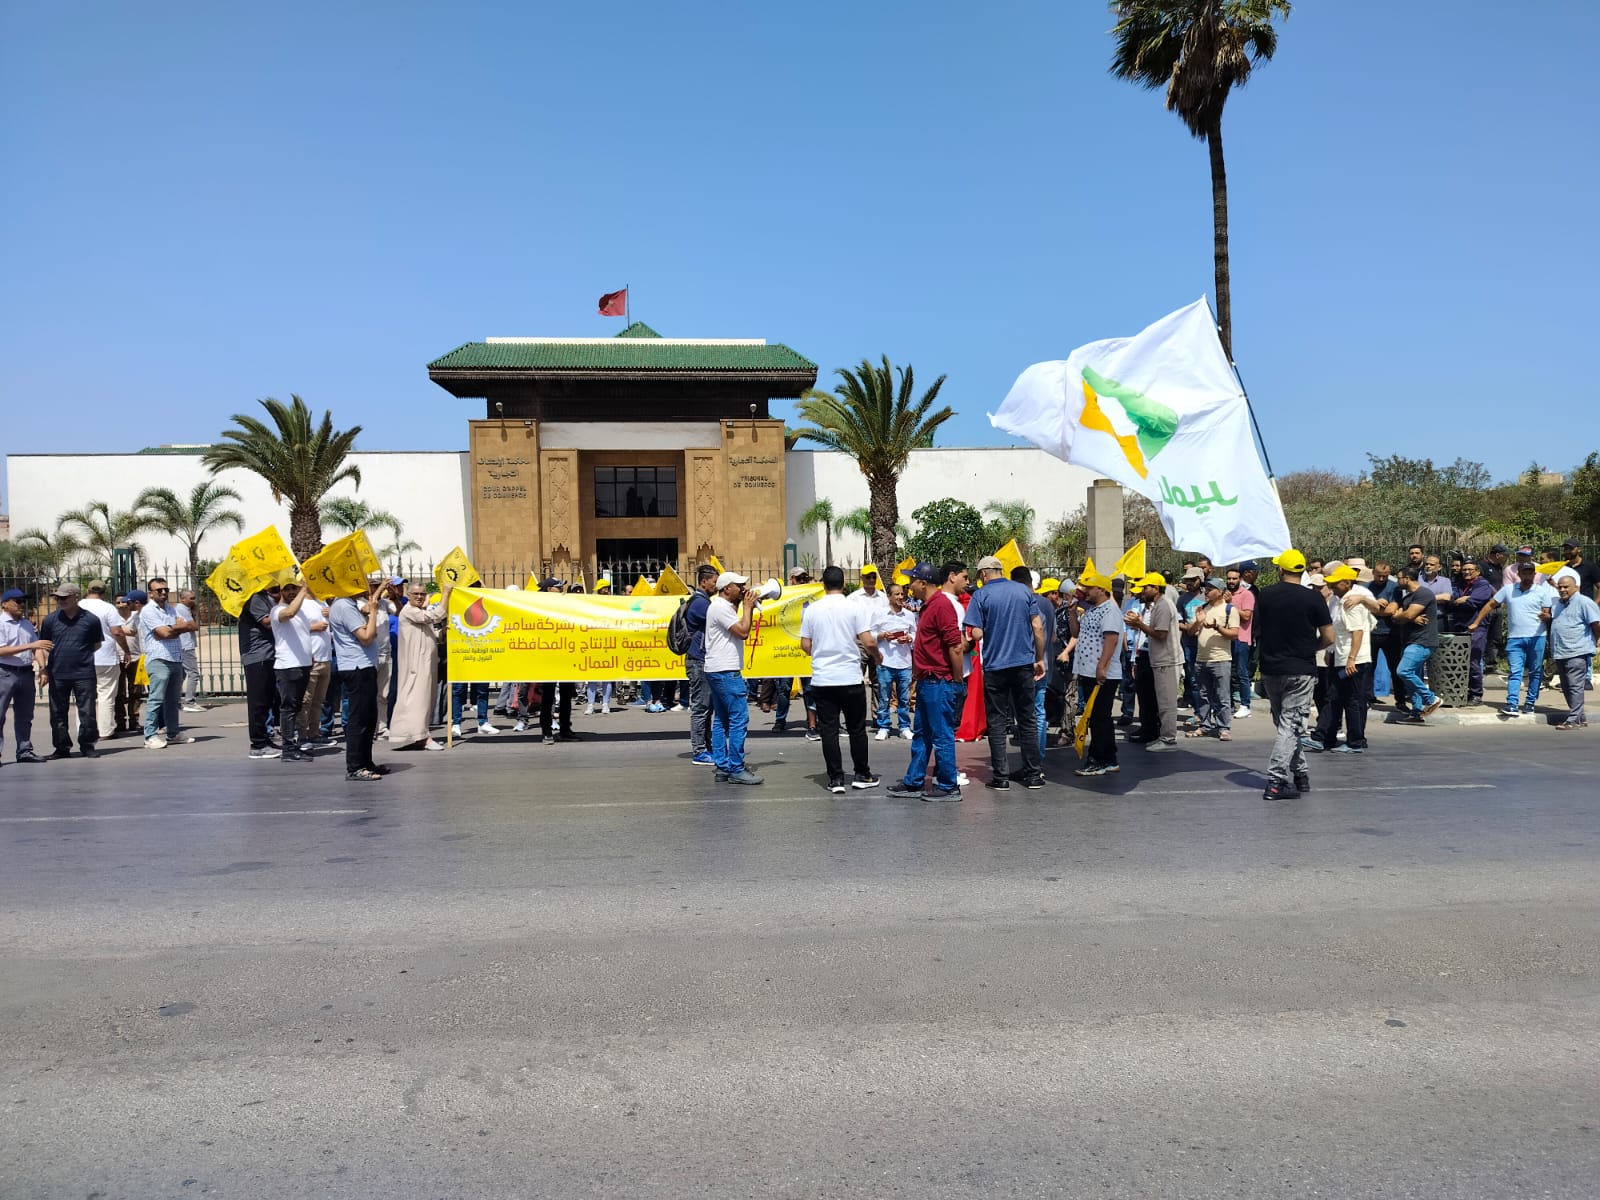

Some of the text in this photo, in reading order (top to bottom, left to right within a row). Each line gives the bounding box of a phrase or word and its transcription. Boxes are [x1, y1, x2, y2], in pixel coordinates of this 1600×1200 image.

[508, 637, 576, 653] والمحافظة
[580, 636, 617, 653] للإنتاج
[621, 635, 668, 652] طبيعية
[623, 656, 661, 672] حقوق
